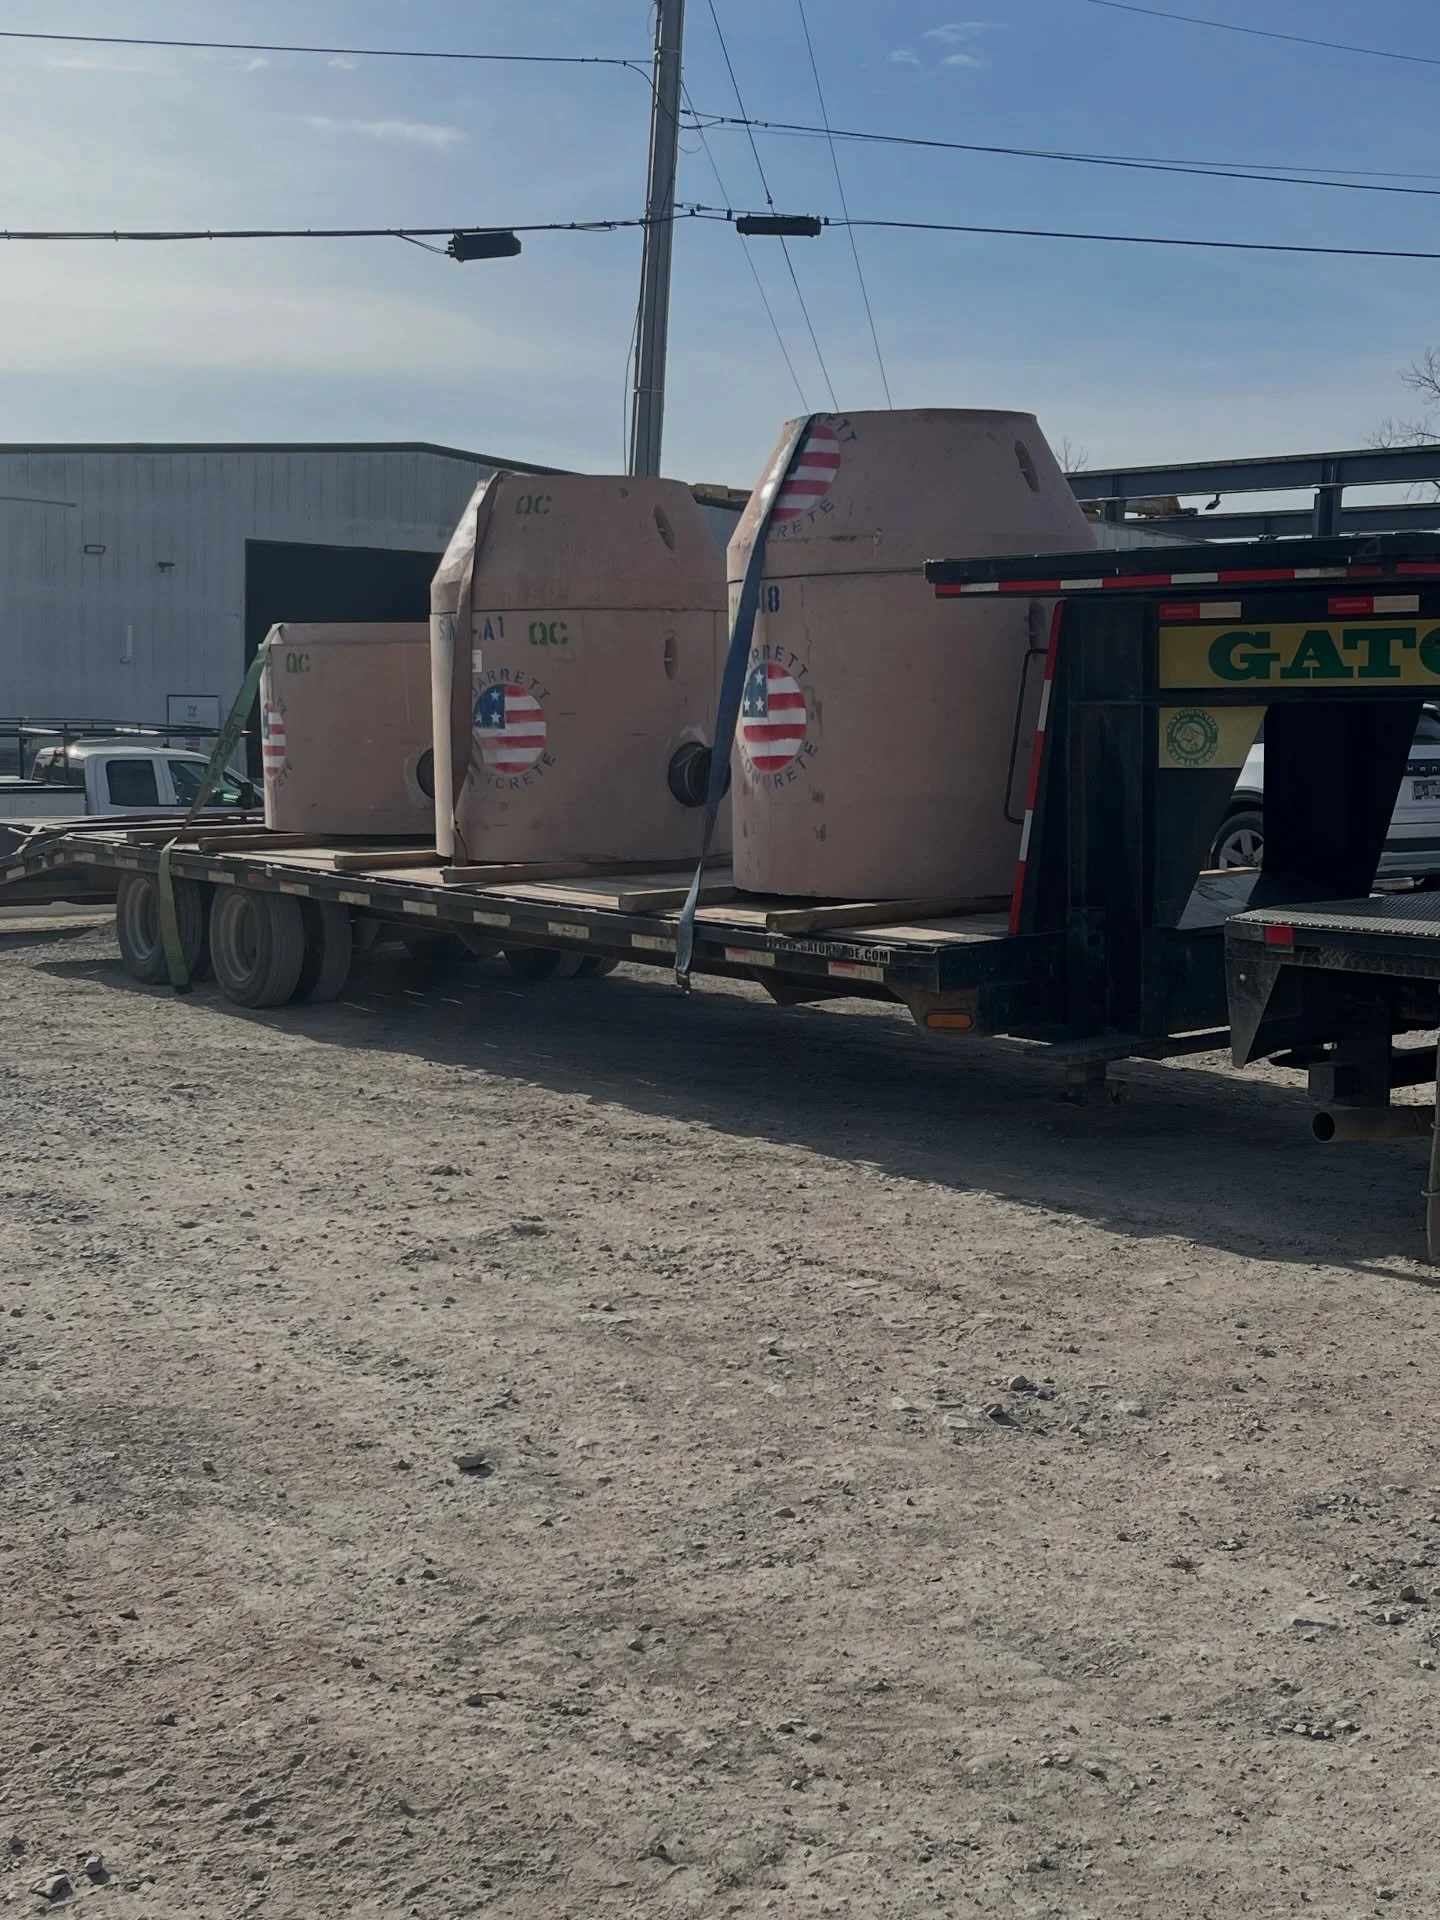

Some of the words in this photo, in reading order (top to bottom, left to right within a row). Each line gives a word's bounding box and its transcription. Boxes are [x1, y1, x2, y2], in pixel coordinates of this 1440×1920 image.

[515, 494, 552, 515] QC
[529, 621, 568, 646] QC
[286, 652, 310, 673] QC
